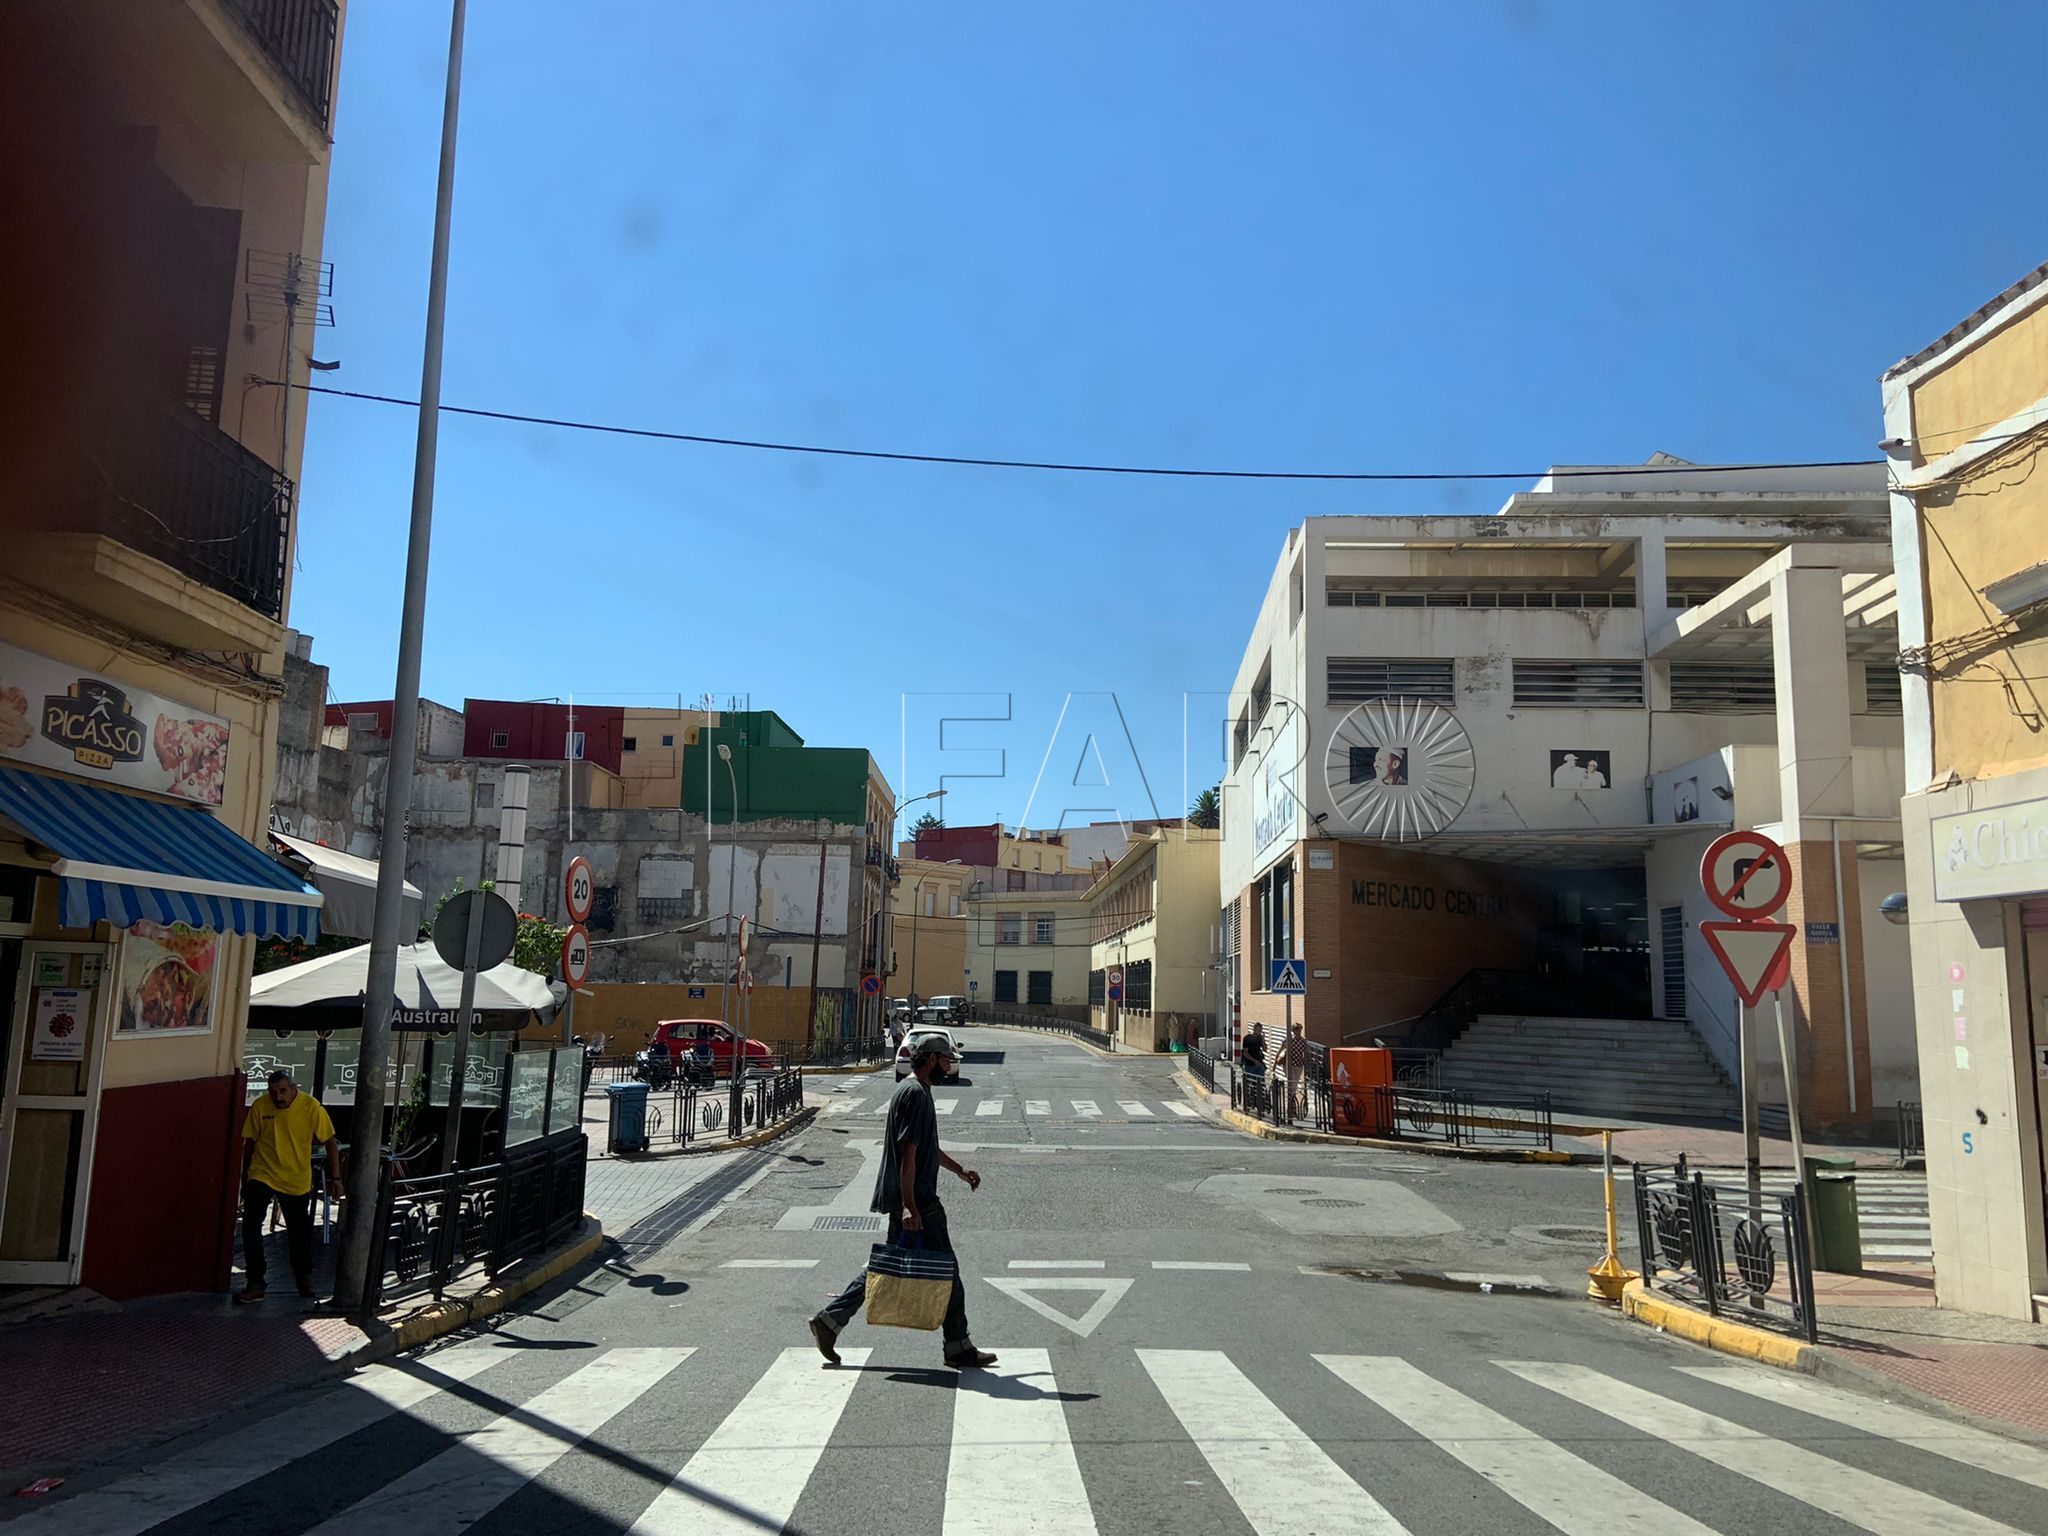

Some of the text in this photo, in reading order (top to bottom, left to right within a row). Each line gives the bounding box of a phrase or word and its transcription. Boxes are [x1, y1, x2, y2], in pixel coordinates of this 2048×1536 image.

[48, 706, 142, 756] PICASSO
[78, 751, 110, 766] PIZZA
[574, 878, 588, 899] 20
[1351, 879, 1434, 911] MERCADO
